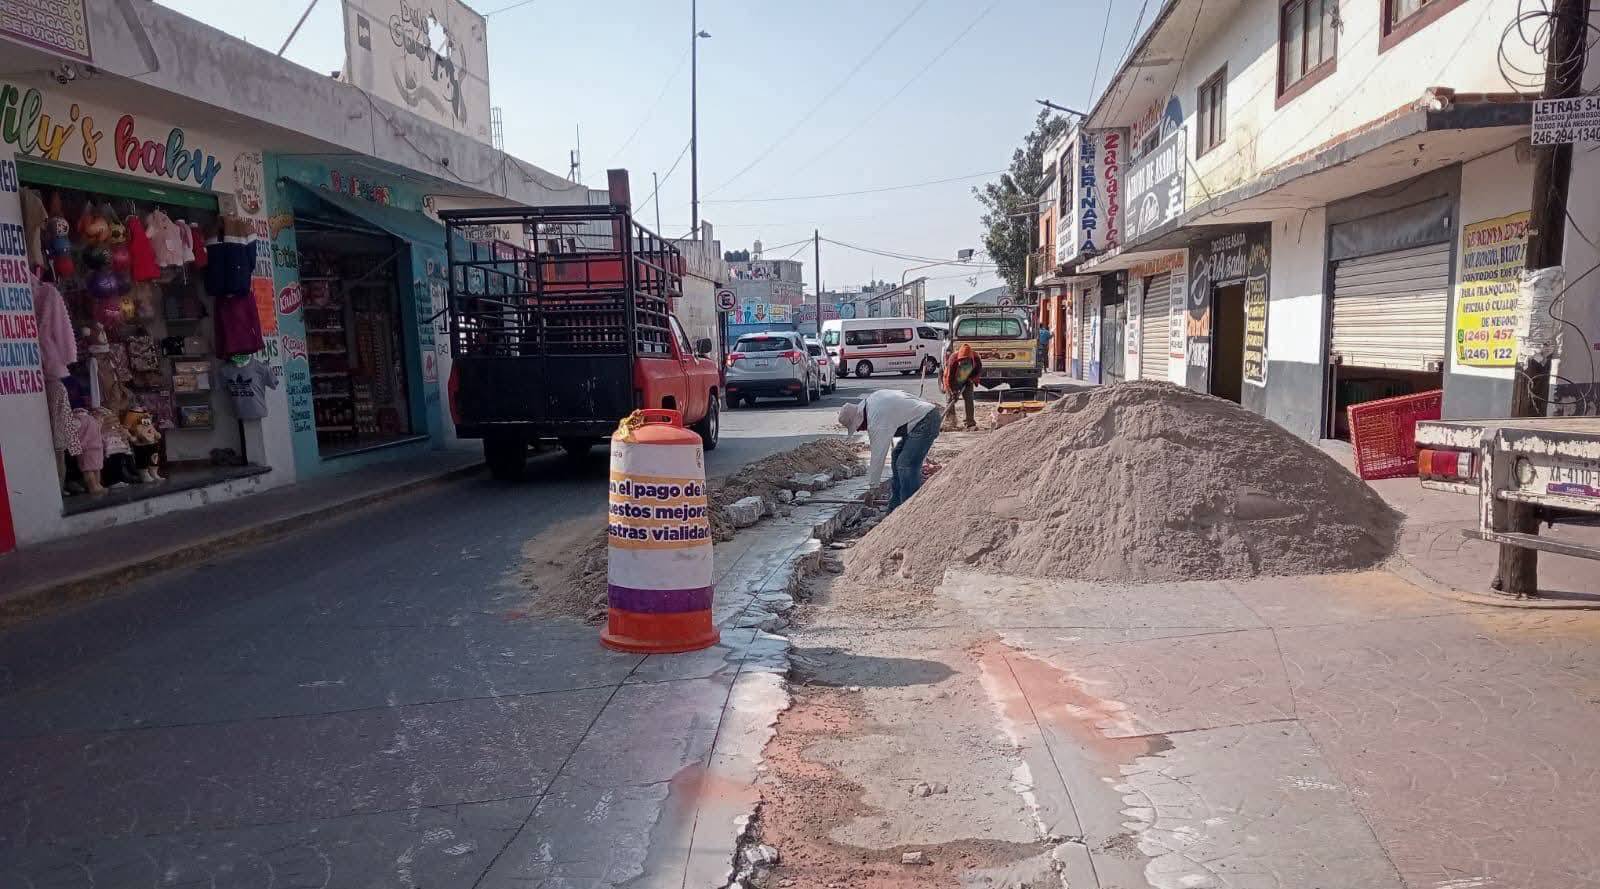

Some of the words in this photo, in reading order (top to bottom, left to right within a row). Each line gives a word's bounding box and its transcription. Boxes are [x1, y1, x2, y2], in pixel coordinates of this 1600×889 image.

[1535, 100, 1581, 114] LETRAS
[1557, 121, 1571, 129] PARA
[115, 115, 222, 191] baby
[1465, 330, 1489, 342] (246)
[1493, 329, 1514, 341] 457
[1465, 348, 1489, 360] (246)
[1494, 348, 1512, 359] 122
[619, 481, 631, 496] el
[634, 484, 681, 499] pago
[684, 482, 700, 497] de
